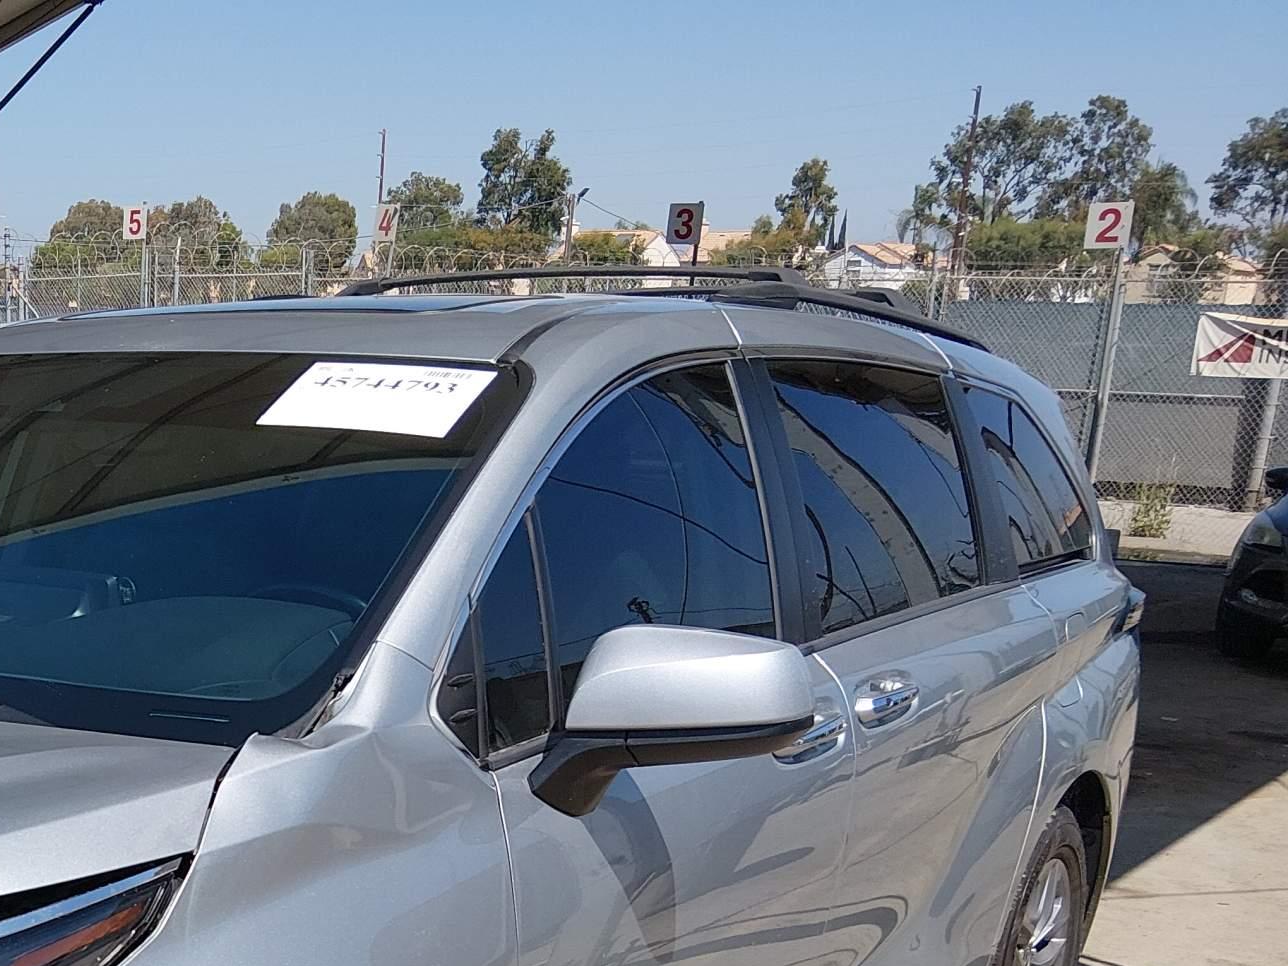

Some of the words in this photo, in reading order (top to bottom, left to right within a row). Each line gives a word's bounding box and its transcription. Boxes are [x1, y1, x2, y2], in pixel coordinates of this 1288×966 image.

[129, 210, 141, 235] 5
[379, 209, 392, 236] 4
[674, 208, 694, 239] 3
[1095, 208, 1122, 243] 2
[1262, 328, 1288, 345] M
[314, 376, 458, 393] 45744793
